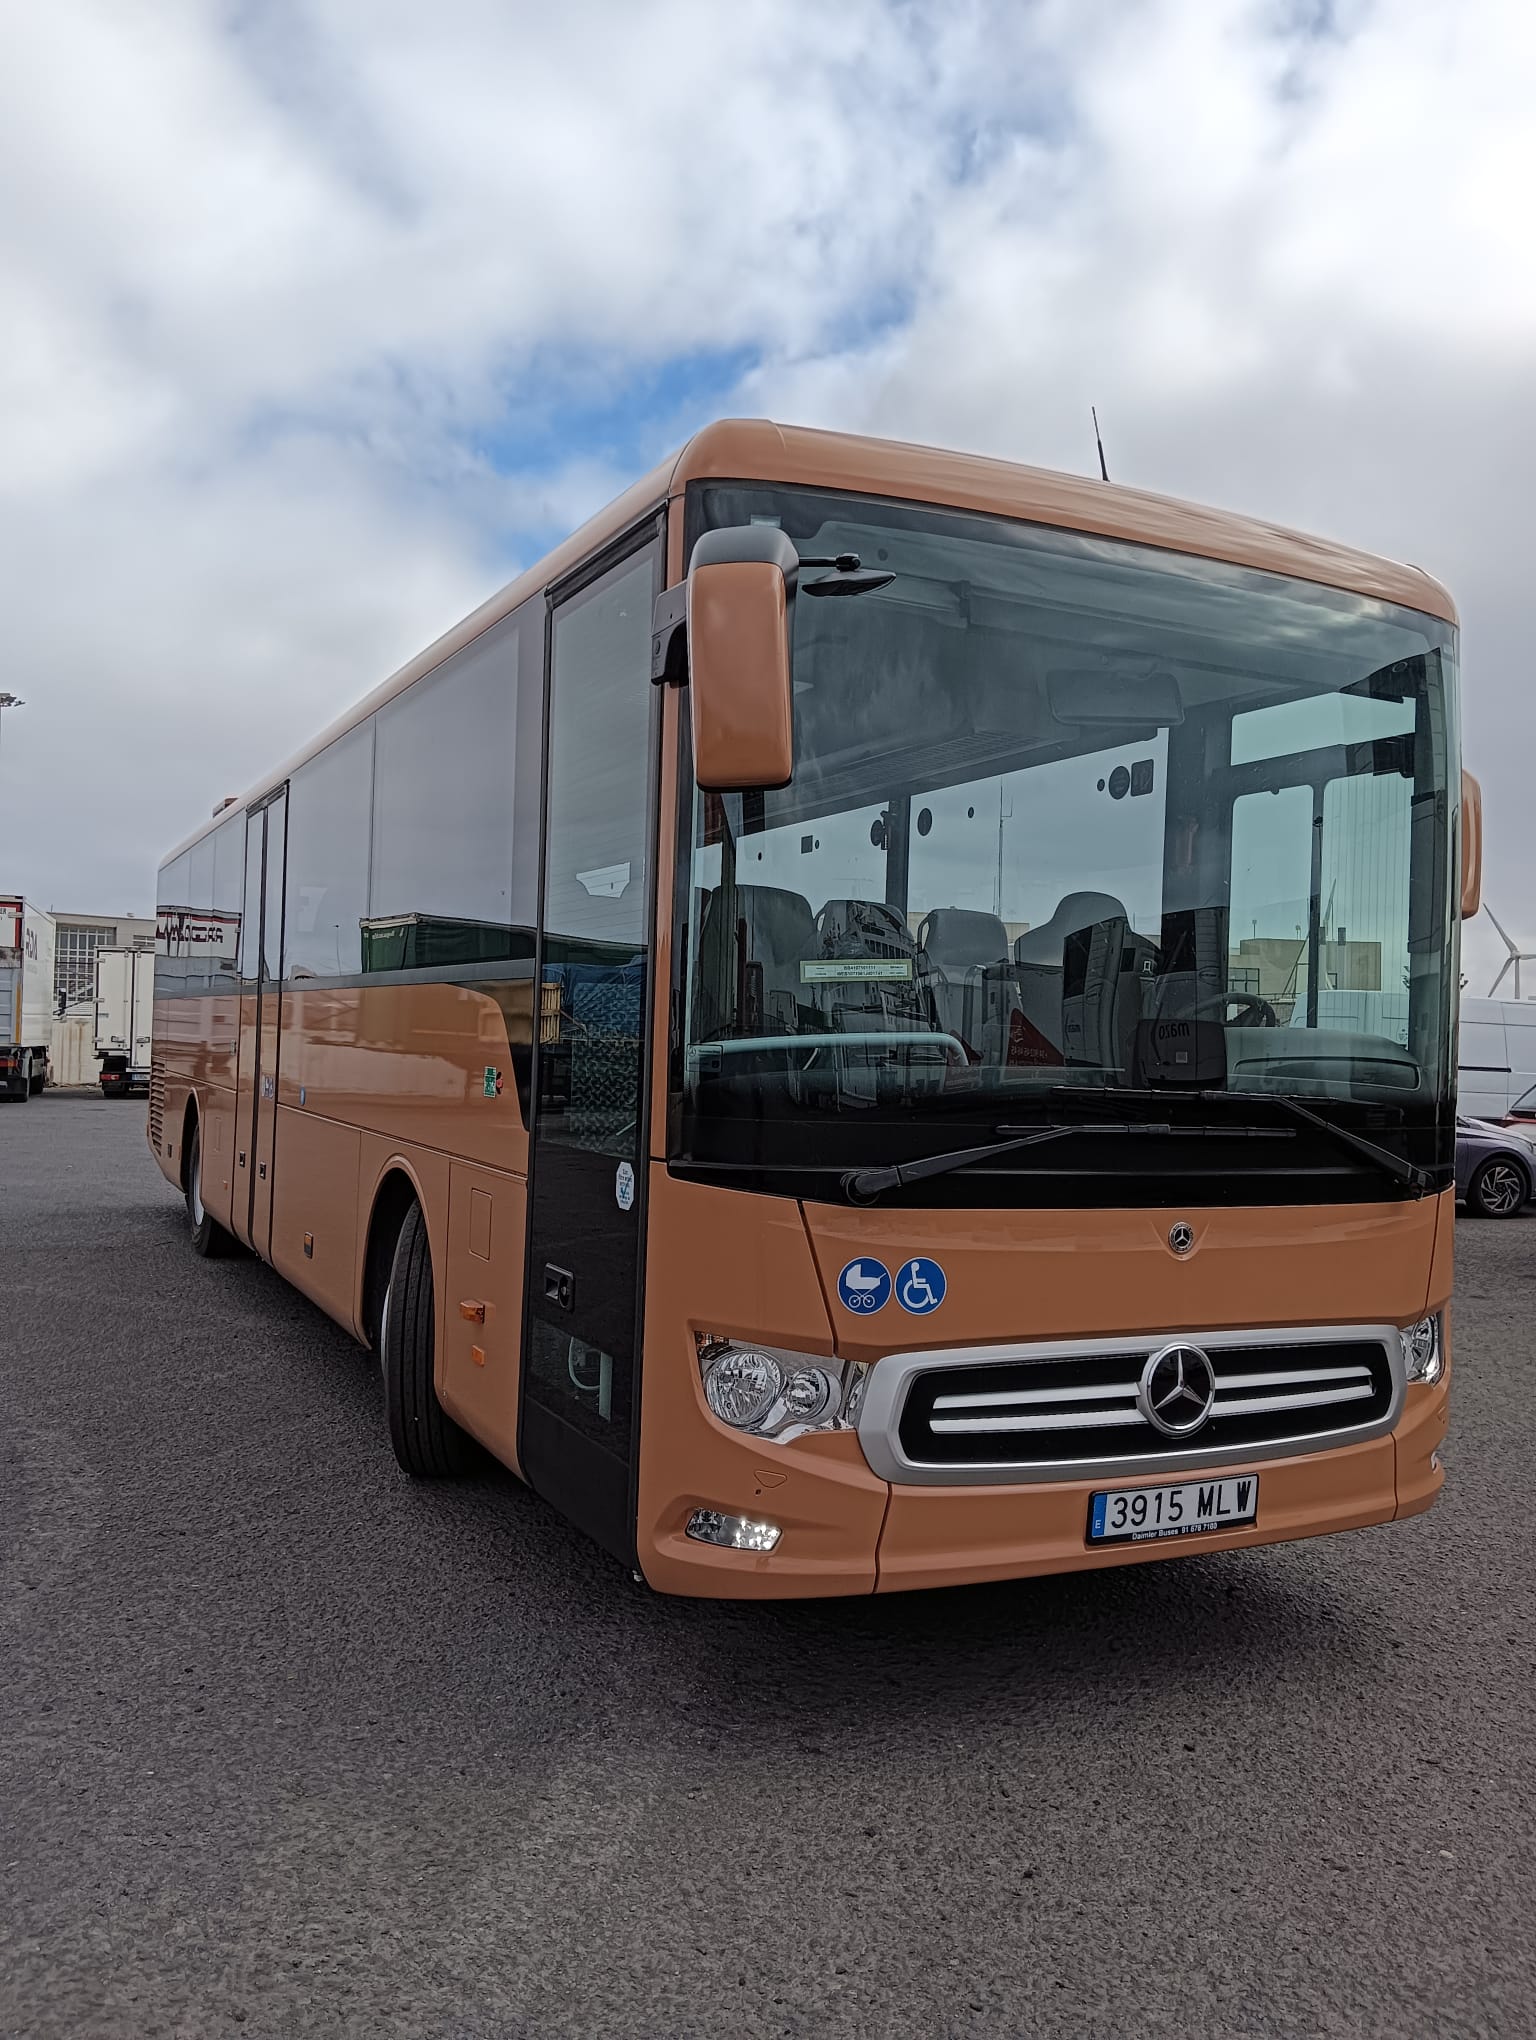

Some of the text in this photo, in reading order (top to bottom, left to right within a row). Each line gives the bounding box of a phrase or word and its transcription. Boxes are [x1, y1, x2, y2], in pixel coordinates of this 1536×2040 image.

[1111, 1480, 1252, 1529] 3915 MLW
[1094, 1519, 1102, 1529] E
[1131, 1530, 1158, 1540] Daimler
[1158, 1528, 1179, 1537] Buses
[1181, 1526, 1189, 1534] 91
